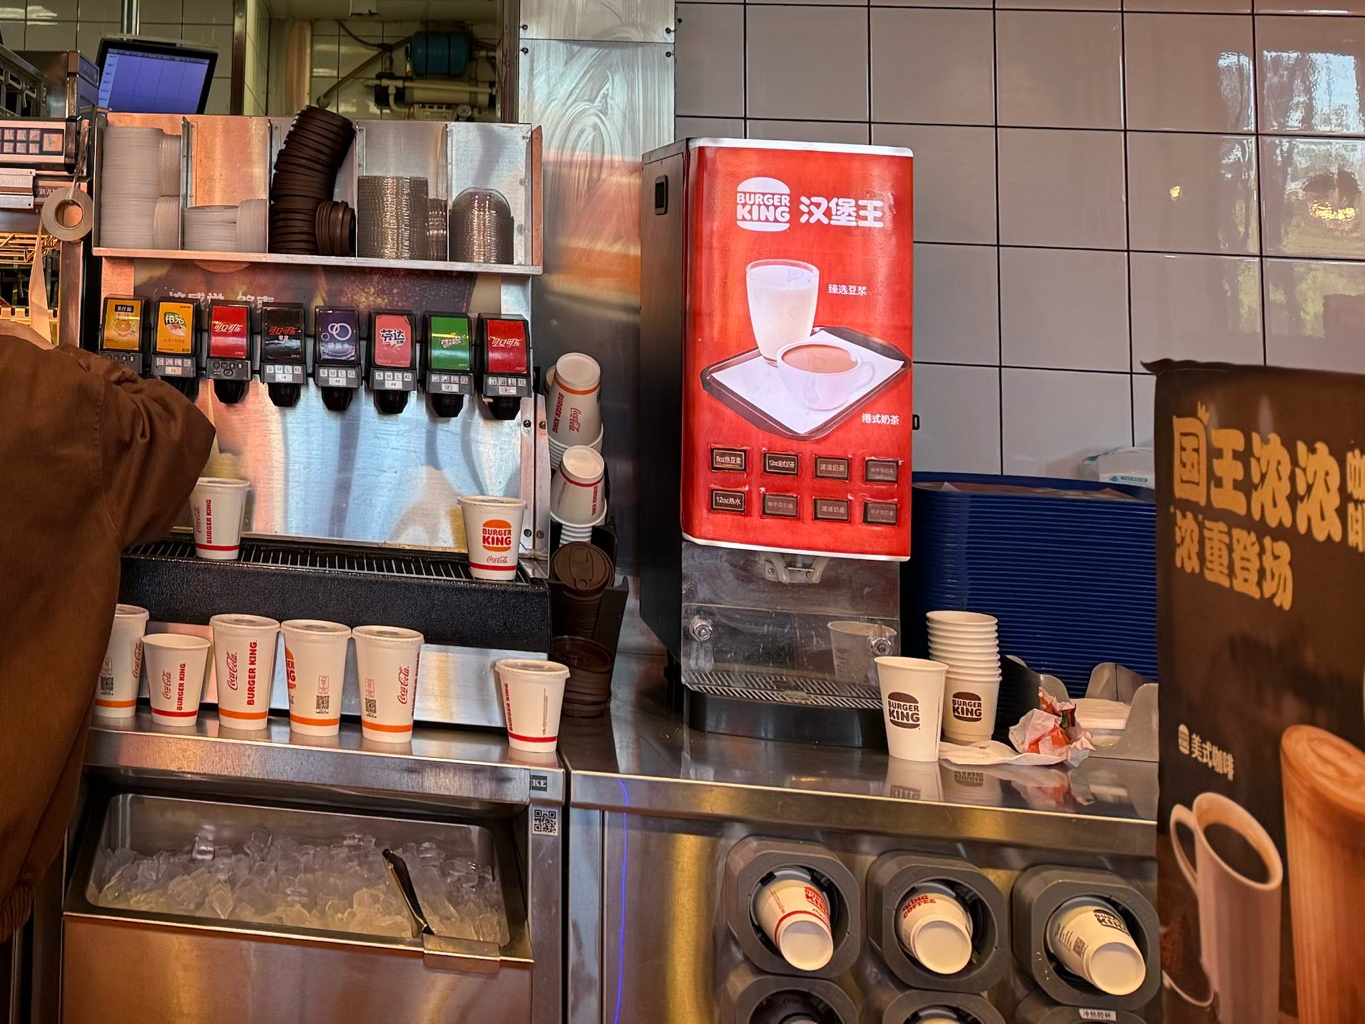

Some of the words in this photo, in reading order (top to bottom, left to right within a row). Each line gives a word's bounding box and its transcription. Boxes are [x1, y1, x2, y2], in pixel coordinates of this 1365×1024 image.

[736, 192, 790, 206] BURGER
[736, 204, 790, 222] KING
[799, 195, 884, 227] 汉堡王
[380, 328, 405, 343] 芬达
[862, 413, 900, 425] 港式奶茶
[1173, 415, 1343, 543] 国王浓浓
[482, 528, 512, 537] BURGER
[482, 536, 512, 546] KING
[249, 641, 258, 666] KING
[247, 667, 257, 706] BURGER
[177, 682, 185, 711] BURGER
[952, 698, 982, 708] BURGER
[888, 700, 919, 713] BURGER
[952, 705, 982, 717] KING
[888, 708, 920, 722] KING
